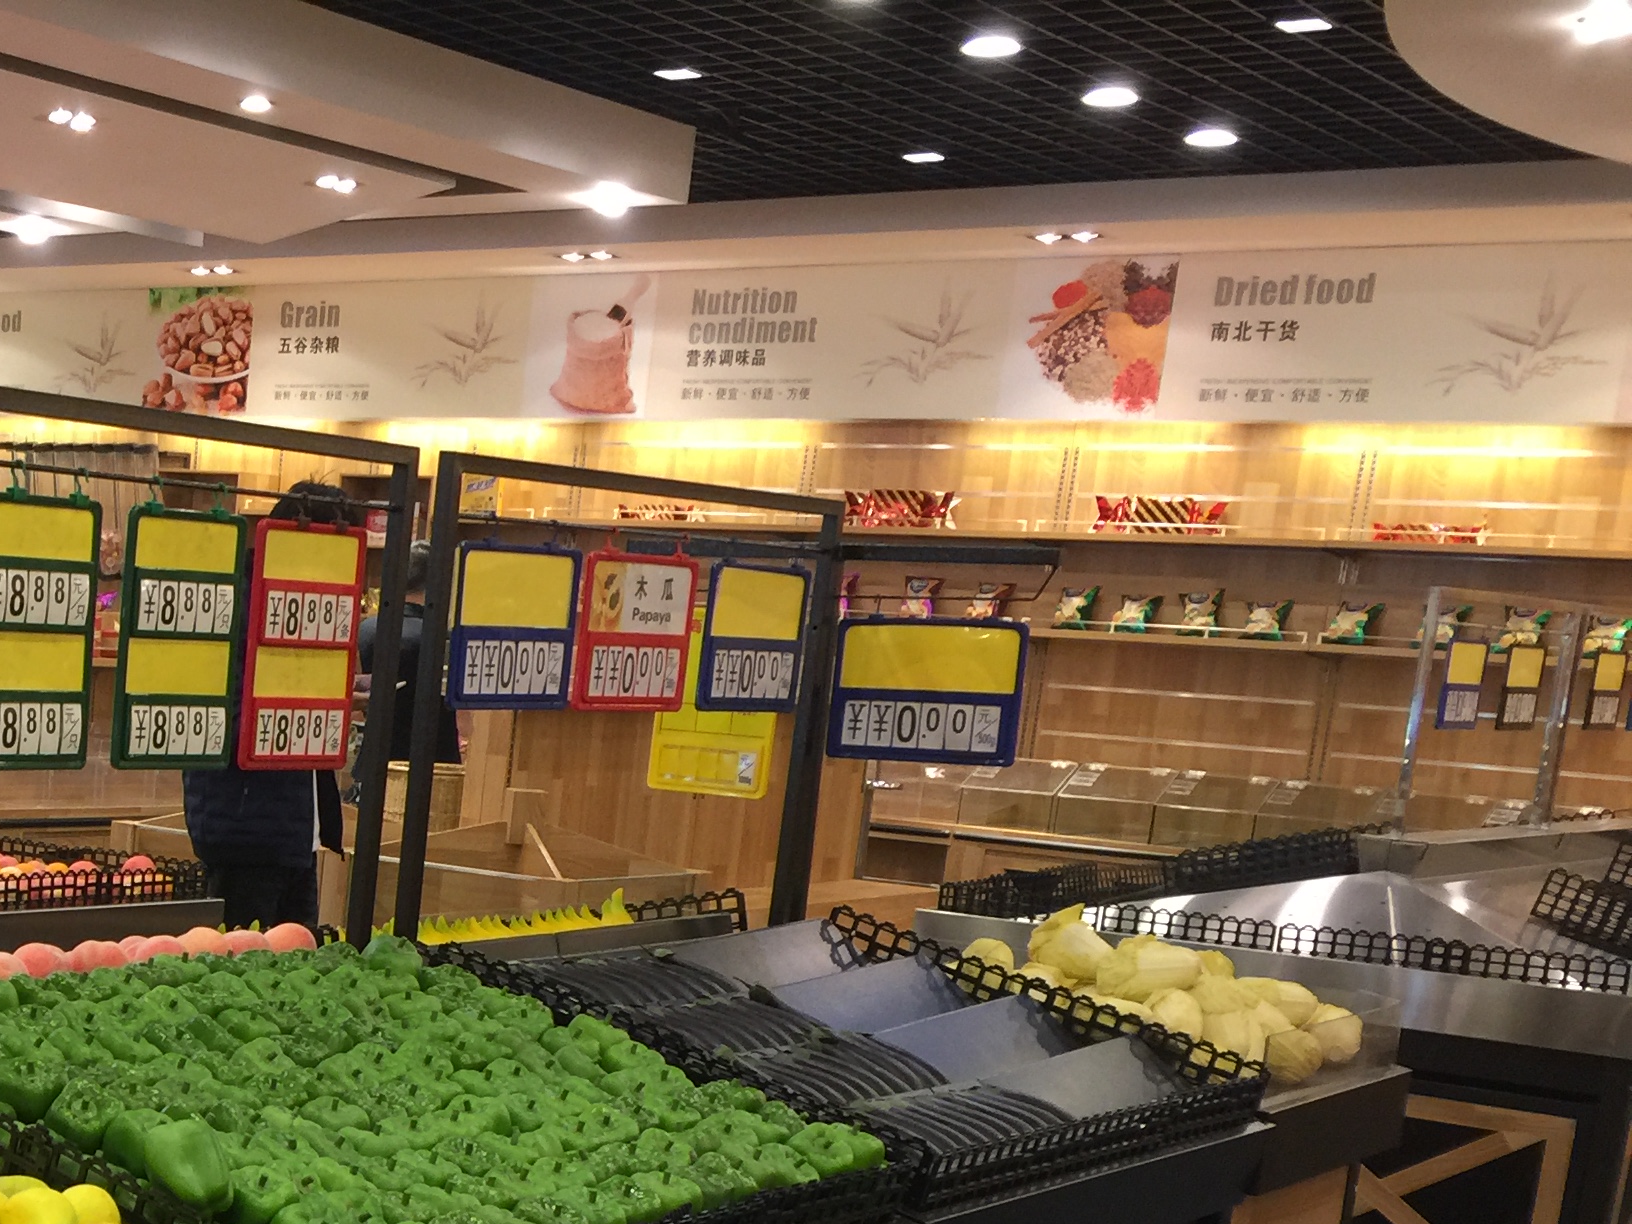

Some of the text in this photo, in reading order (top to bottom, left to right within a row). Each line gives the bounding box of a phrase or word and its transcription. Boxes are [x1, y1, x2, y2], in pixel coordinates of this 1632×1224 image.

[692, 287, 798, 316] Nutrition
[1214, 272, 1377, 307] Dried food
[280, 301, 341, 329] Grain
[688, 317, 818, 345] condiment
[1211, 319, 1300, 342] 南北干货
[278, 335, 340, 355] 五谷杂粮
[686, 348, 767, 368] 营养调味品
[635, 575, 674, 601] 木瓜
[144, 584, 211, 625] ¥8.88
[269, 596, 333, 636] ¥8.88
[632, 607, 671, 626] Papaya
[467, 644, 546, 689] ¥¥0.00
[594, 649, 664, 693] ¥¥0.00
[134, 709, 203, 750] ¥8.88
[260, 714, 322, 752] ¥8.88
[847, 703, 967, 743] ¥¥0.00
